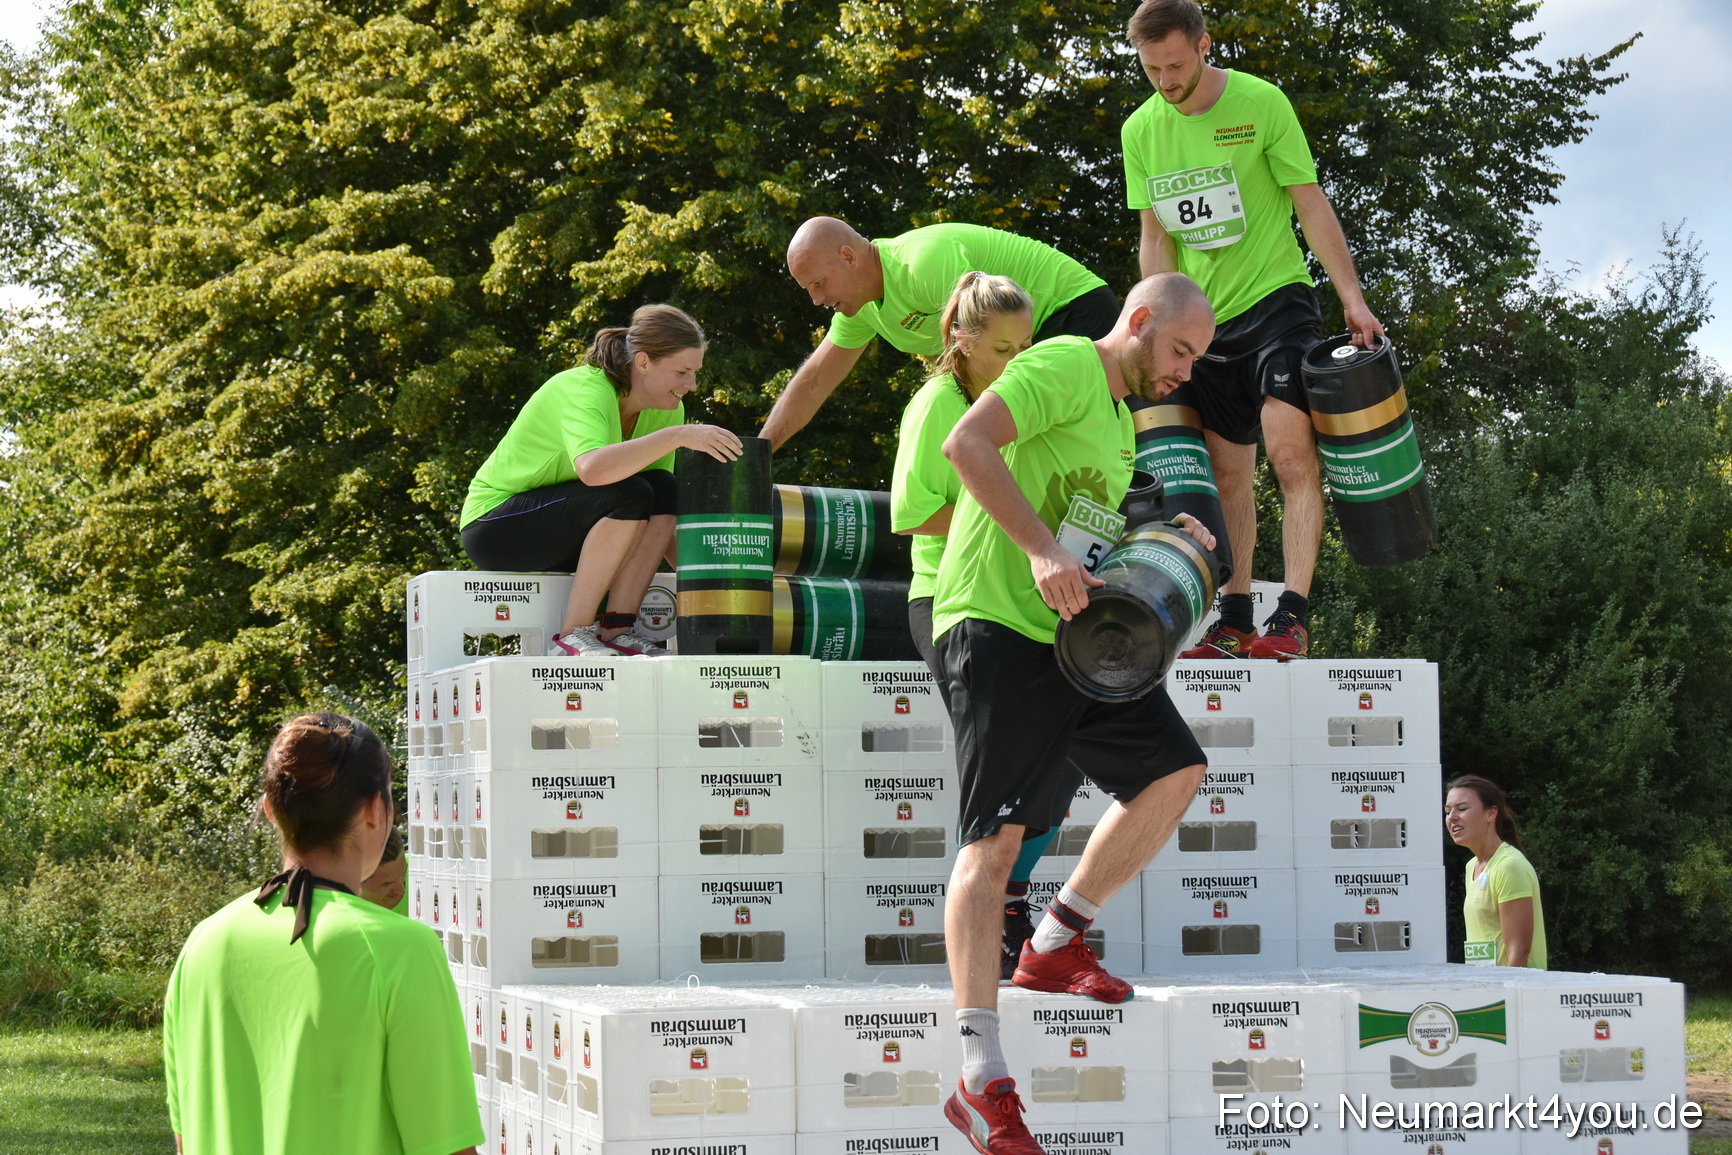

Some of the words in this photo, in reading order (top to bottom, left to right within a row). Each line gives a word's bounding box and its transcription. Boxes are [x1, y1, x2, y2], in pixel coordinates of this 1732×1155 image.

[1213, 131, 1256, 141] ELEMENTELAUF
[1215, 124, 1254, 134] NEUMARKTER
[1153, 167, 1227, 198] BOCK
[1178, 195, 1213, 225] 84
[1181, 225, 1226, 242] PHILIPP
[1146, 455, 1198, 469] Neumarkter
[834, 500, 843, 550] Neumarkter
[842, 495, 854, 560] Lammsbräu
[1072, 501, 1125, 541] BOCK
[703, 534, 770, 548] Lammsbräu
[712, 547, 763, 557] Neumarkter
[1084, 542, 1102, 572] 5
[464, 581, 540, 596] Lammsbräu
[474, 594, 530, 604] Neumarkter
[532, 667, 615, 682] Lammsbräu
[700, 666, 780, 681] Lammsbräu
[862, 672, 933, 686] ammsbräu
[1176, 669, 1251, 684] Lammsbräu
[1328, 669, 1402, 682] Lammsbräu
[542, 681, 604, 691] Neumarkter
[710, 680, 770, 690] Neumarkter
[872, 685, 931, 695] Neumarkter
[1185, 683, 1241, 692] Neumarkter
[1338, 682, 1392, 691] Neumarkter
[532, 775, 615, 791] Lammsbräu
[701, 773, 782, 788] Lammsbräu
[864, 777, 944, 793] Lammsbräu
[1331, 771, 1405, 785] Lammsbräu
[542, 789, 604, 800] Neumarkter
[711, 787, 771, 798] Neumarkter
[875, 791, 933, 801] Neumarkter
[1197, 786, 1244, 796] Neumarkt
[1341, 785, 1395, 795] Neumarkter
[1182, 876, 1257, 890] Lammsbräu
[1335, 873, 1408, 887] Lammsbräu
[533, 884, 616, 900] Lammsbräu
[701, 880, 783, 896] Lammsbräu
[866, 883, 945, 899] Lammsbräu
[1192, 889, 1247, 899] Neumarkter
[1344, 887, 1399, 896] Neumarkter
[543, 898, 605, 909] Neumarkter
[712, 895, 772, 905] Neumarkter
[876, 897, 935, 907] Neumarkter
[1464, 944, 1490, 958] CK
[1560, 992, 1643, 1008] Lammsbräu
[1212, 1001, 1300, 1018] Lammsbräu
[1571, 1007, 1632, 1018] Neumarkter
[844, 1012, 937, 1030] Lammsbräu
[1033, 1009, 1123, 1025] Lammsbräu
[1223, 1017, 1288, 1028] Neumarkter
[651, 1018, 746, 1036] Lammsbräu
[856, 1028, 925, 1040] Neumarkter
[1045, 1024, 1111, 1036] Neumarkter
[663, 1034, 733, 1047] Neumarkter
[845, 1136, 939, 1154] Lammsbräu
[1034, 1132, 1124, 1148] Lammsbräu
[1403, 1132, 1466, 1144] Neumarkter
